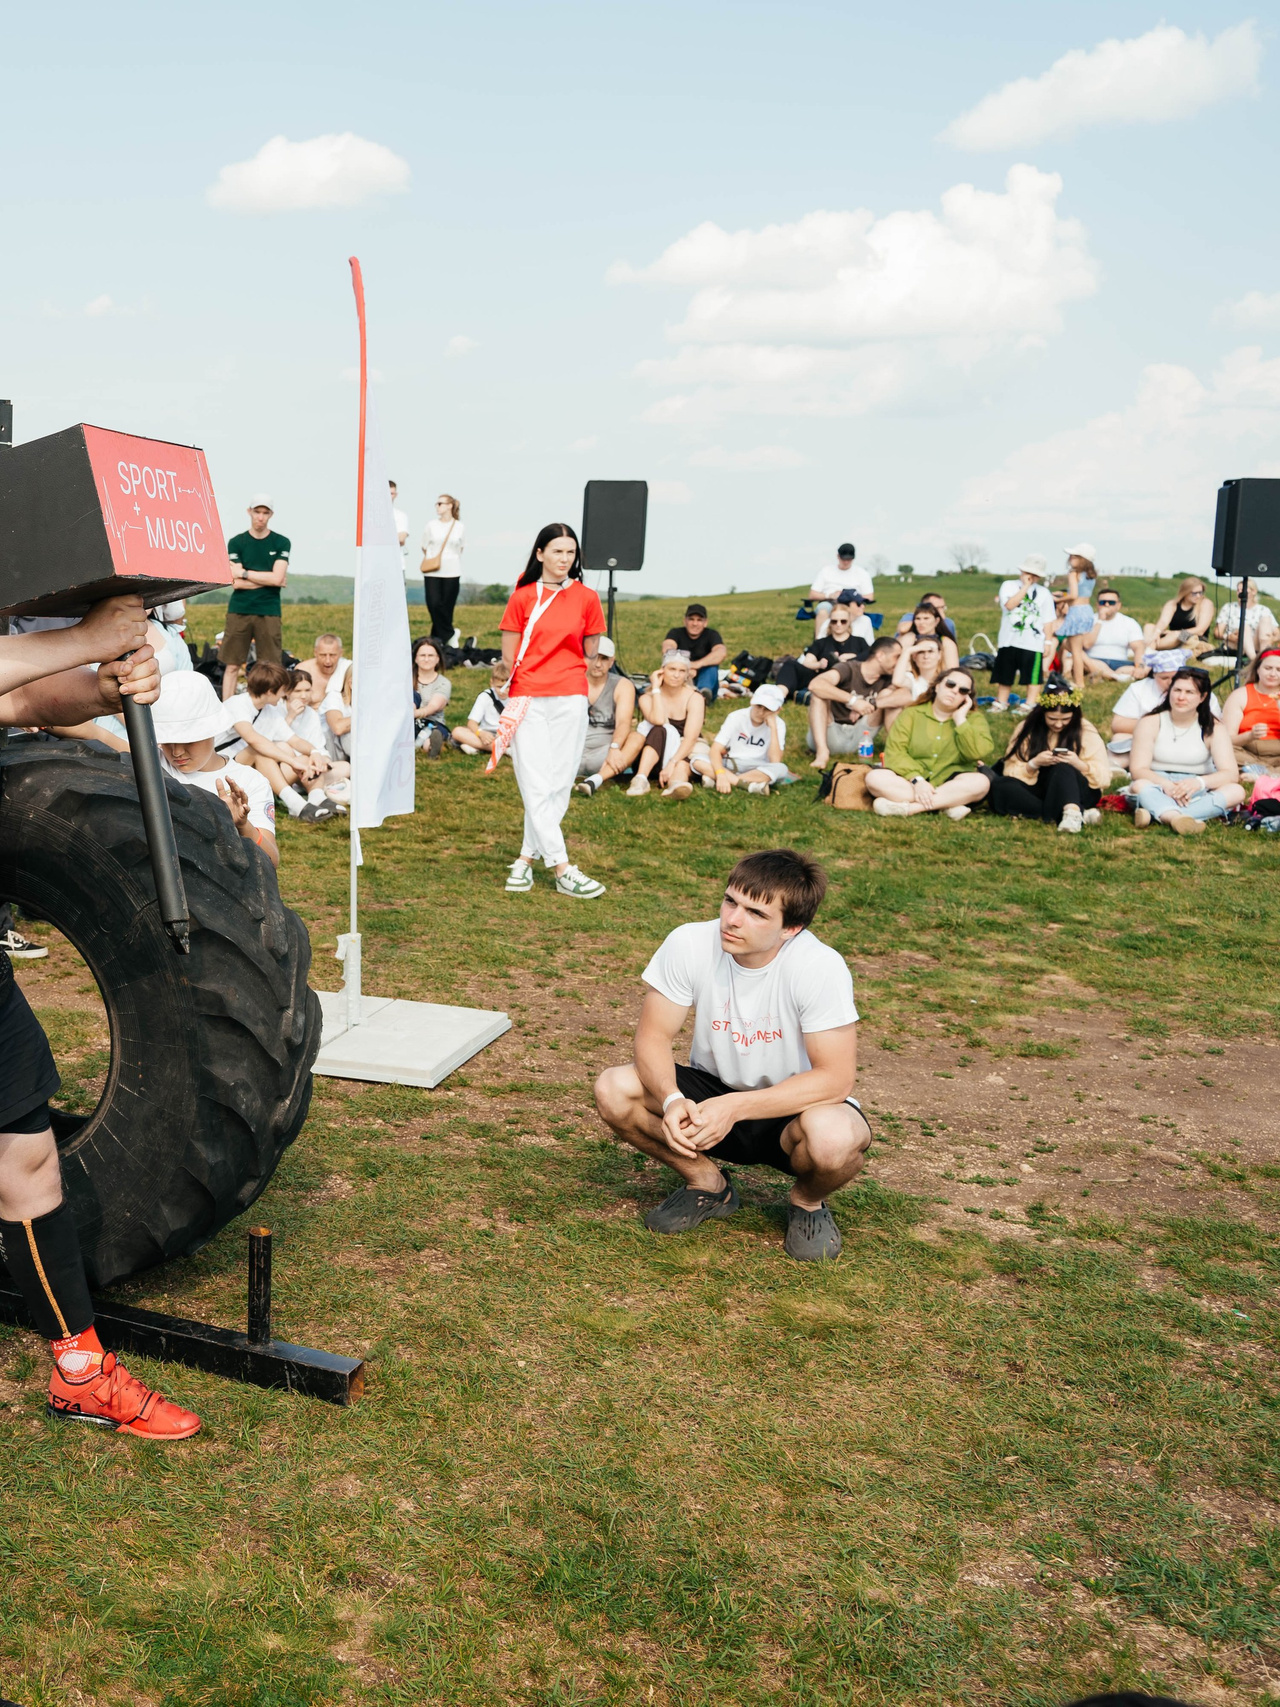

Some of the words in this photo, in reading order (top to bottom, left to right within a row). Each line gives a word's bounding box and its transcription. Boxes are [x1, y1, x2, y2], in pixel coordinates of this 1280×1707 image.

[117, 461, 178, 502] SPORT
[145, 515, 205, 554] MUSIC
[738, 732, 765, 747] FILA
[711, 1020, 783, 1047] STONGMEN
[49, 1390, 81, 1412] F74
